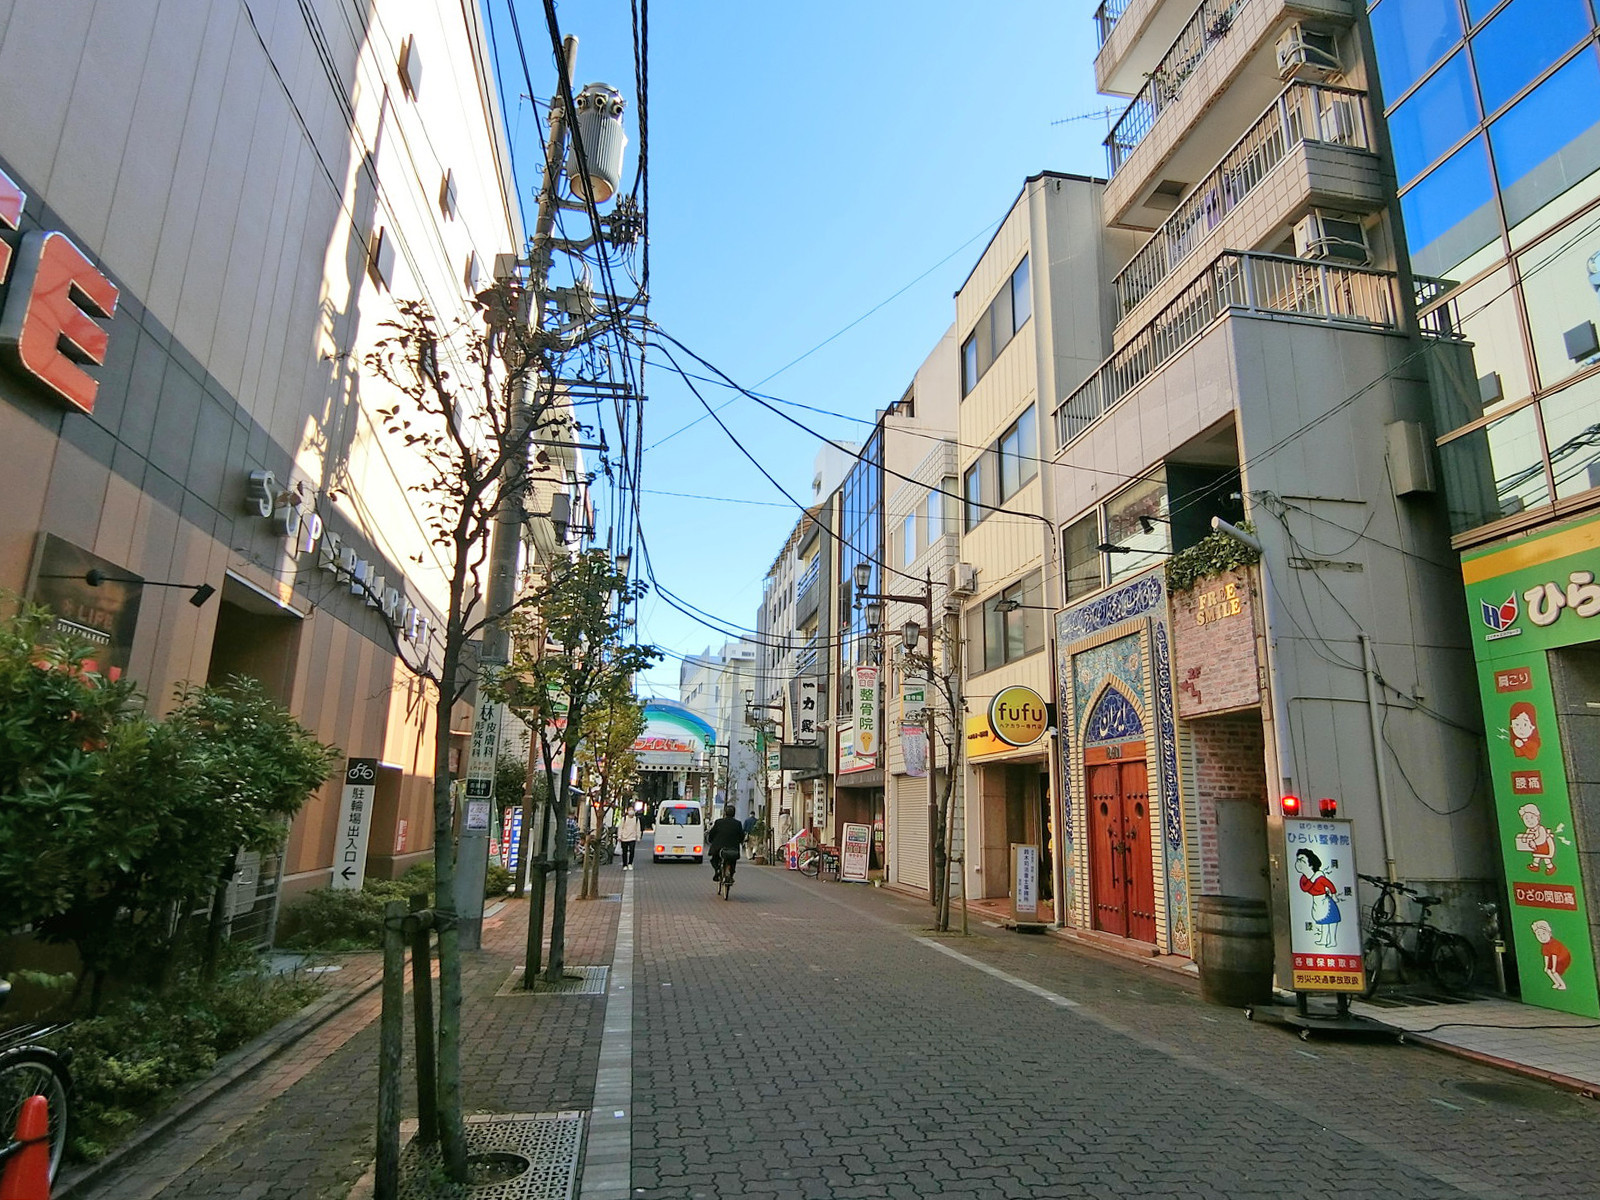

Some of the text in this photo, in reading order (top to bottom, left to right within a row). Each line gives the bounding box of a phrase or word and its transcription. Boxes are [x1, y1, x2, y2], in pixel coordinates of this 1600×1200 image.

[1199, 583, 1236, 610] FREE
[1197, 598, 1242, 626] SMILE
[1498, 672, 1528, 687] 肩こり
[860, 688, 874, 731] 整骨院
[998, 702, 1043, 722] fufu
[1515, 776, 1540, 789] 腰痛
[344, 787, 365, 863] 駐輪場出入口
[1288, 832, 1350, 846] ひらい整骨院
[1516, 889, 1575, 905] ひざの関節痛
[1295, 957, 1357, 968] 各種保険取扱
